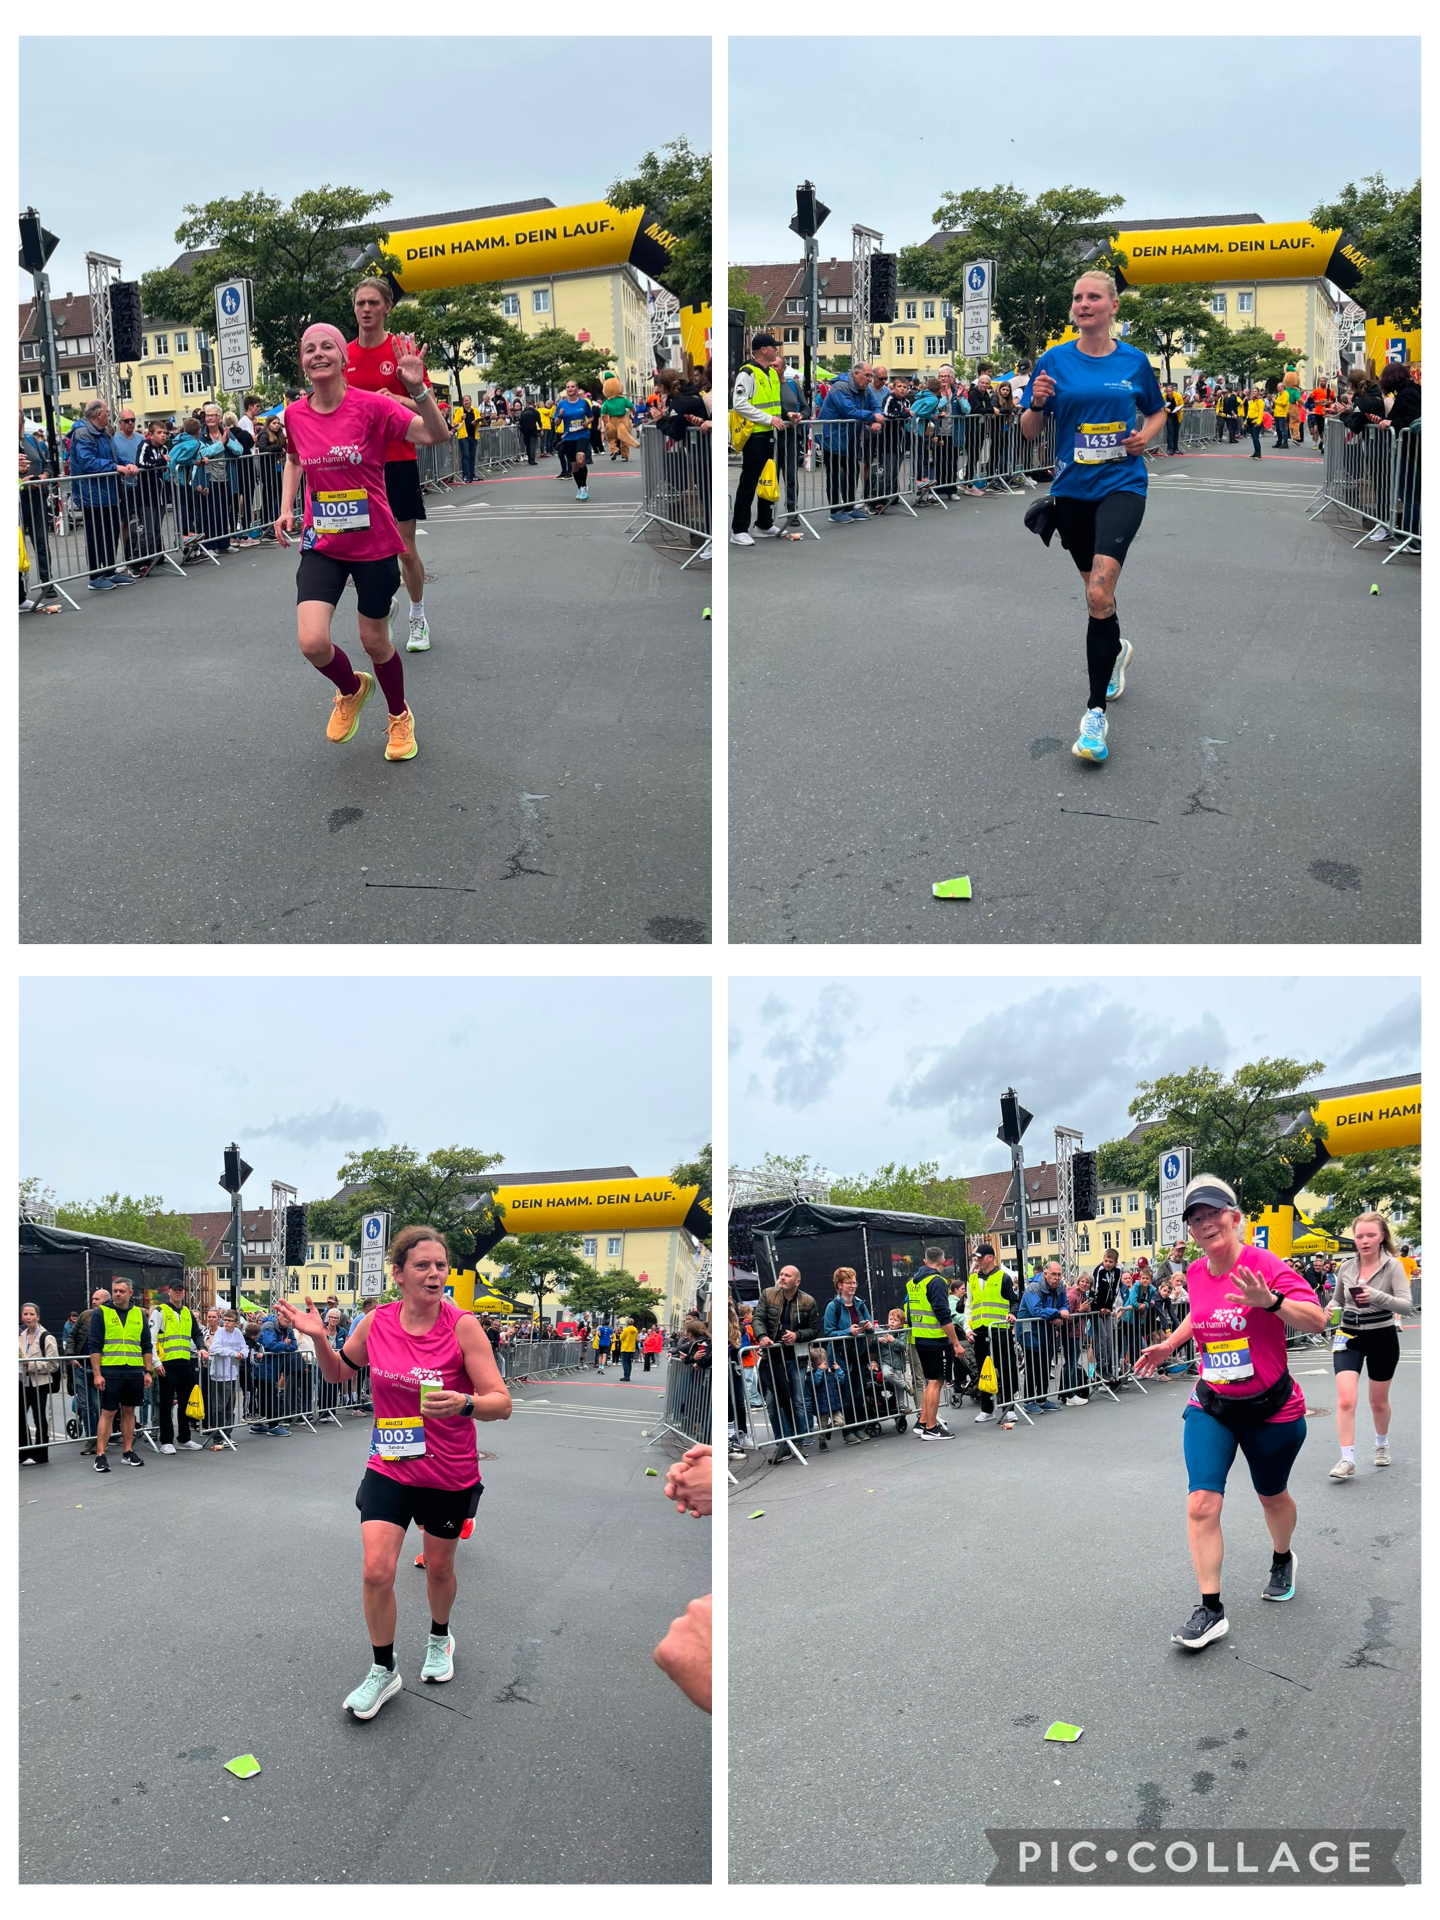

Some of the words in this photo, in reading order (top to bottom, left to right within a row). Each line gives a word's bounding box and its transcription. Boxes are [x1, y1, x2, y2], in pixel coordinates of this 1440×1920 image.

[406, 244, 446, 261] DEIN
[451, 235, 510, 255] HAMM.
[515, 227, 557, 246] DEIN
[563, 219, 616, 238] LAUF.
[1132, 246, 1167, 258] DEIN
[1171, 242, 1223, 256] HAMM.
[1228, 240, 1265, 253] DEIN
[1270, 237, 1315, 250] LAUF.
[225, 315, 240, 325] ZONE
[229, 336, 239, 344] frei
[232, 377, 242, 385] frei
[1083, 433, 1117, 448] 1433
[308, 456, 321, 465] bad
[322, 455, 346, 464] hamm
[319, 501, 359, 516] 1005
[1336, 1110, 1373, 1127] DEIN
[1166, 1179, 1179, 1189] ZONE
[512, 1198, 542, 1209] DEIN
[546, 1196, 593, 1208] HAMM.
[596, 1193, 630, 1205] DEIN
[634, 1191, 676, 1203] LAUF.
[1206, 1320, 1227, 1329] hamm
[1208, 1352, 1241, 1367] 1008
[384, 1370, 399, 1380] bad
[378, 1429, 414, 1443] 1003
